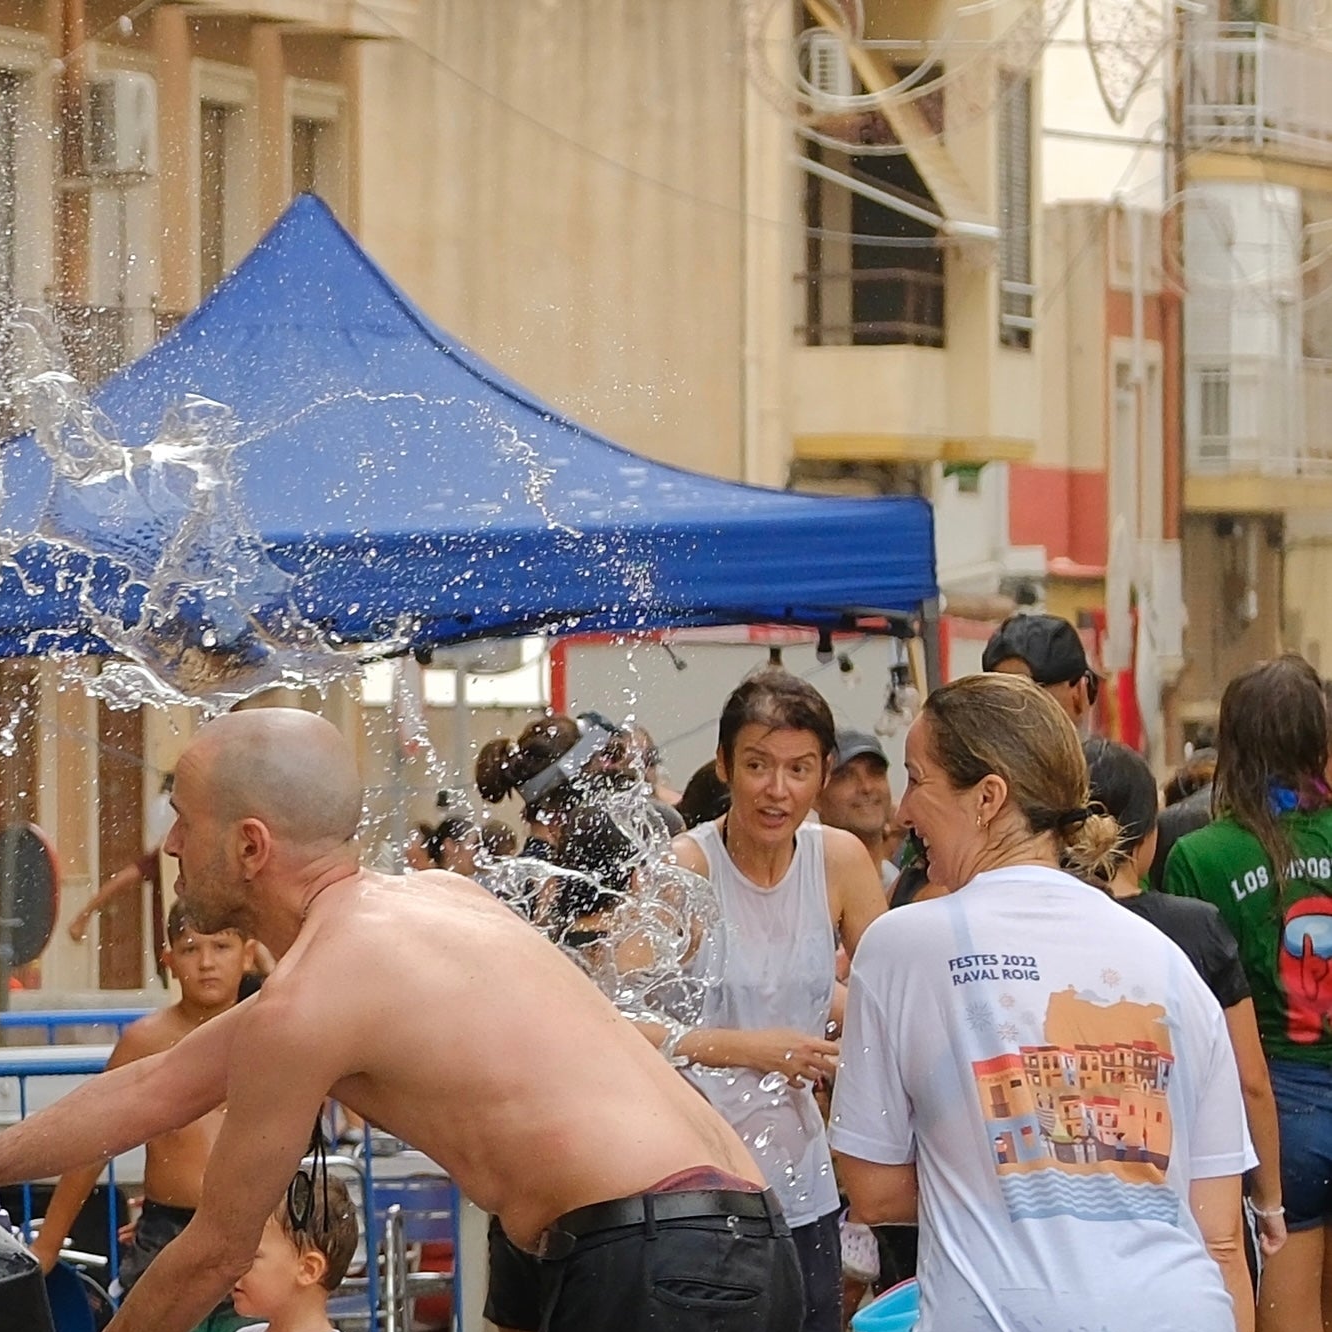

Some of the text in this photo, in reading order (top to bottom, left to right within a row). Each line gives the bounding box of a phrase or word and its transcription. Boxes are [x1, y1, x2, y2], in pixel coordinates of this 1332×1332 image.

[1231, 865, 1269, 902] LOS
[948, 954, 1037, 971] FESTES 2022
[952, 969, 1040, 986] RAVAL ROIG
